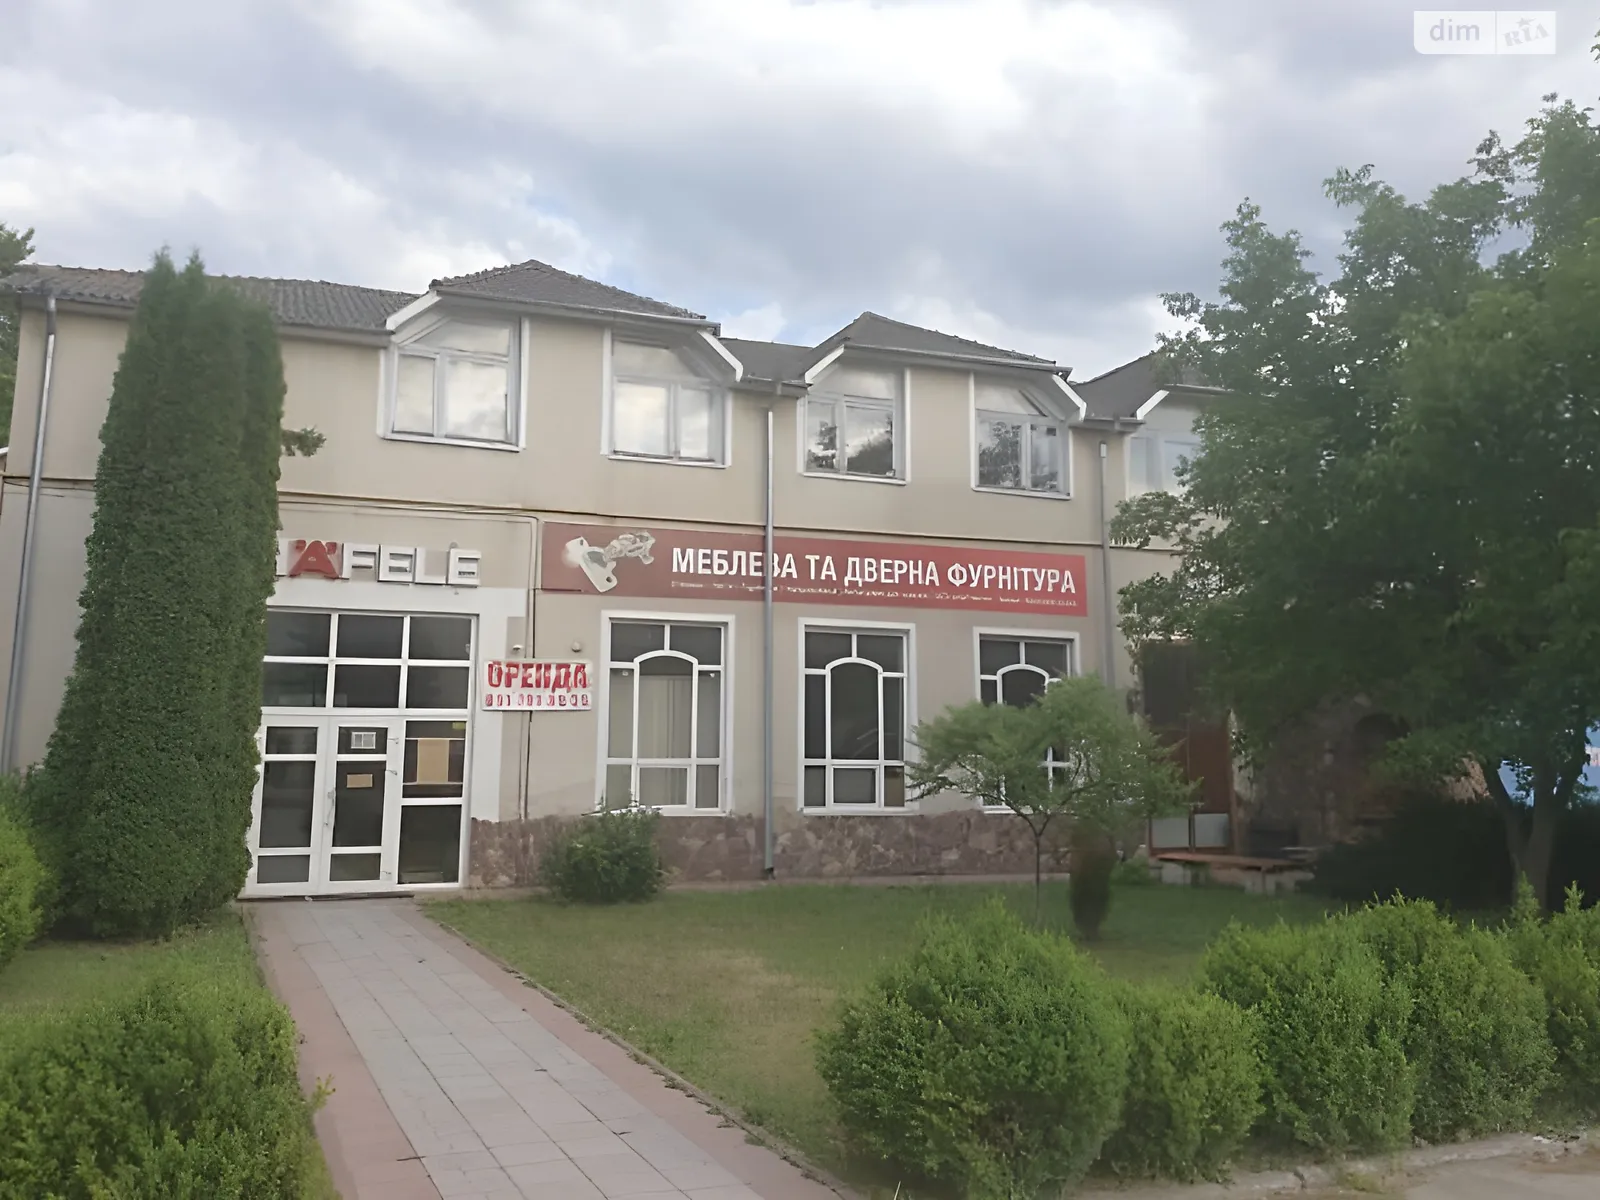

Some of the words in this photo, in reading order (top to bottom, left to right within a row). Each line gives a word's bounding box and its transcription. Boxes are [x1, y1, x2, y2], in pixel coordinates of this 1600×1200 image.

[276, 538, 481, 587] ÄFELE
[671, 547, 798, 579] МЕБЛЕВА
[804, 554, 837, 581] ТА
[843, 556, 940, 587] ДВЕРНА
[946, 562, 1076, 594] ФУРНІТУРА
[487, 661, 587, 693] ОРЕНДА
